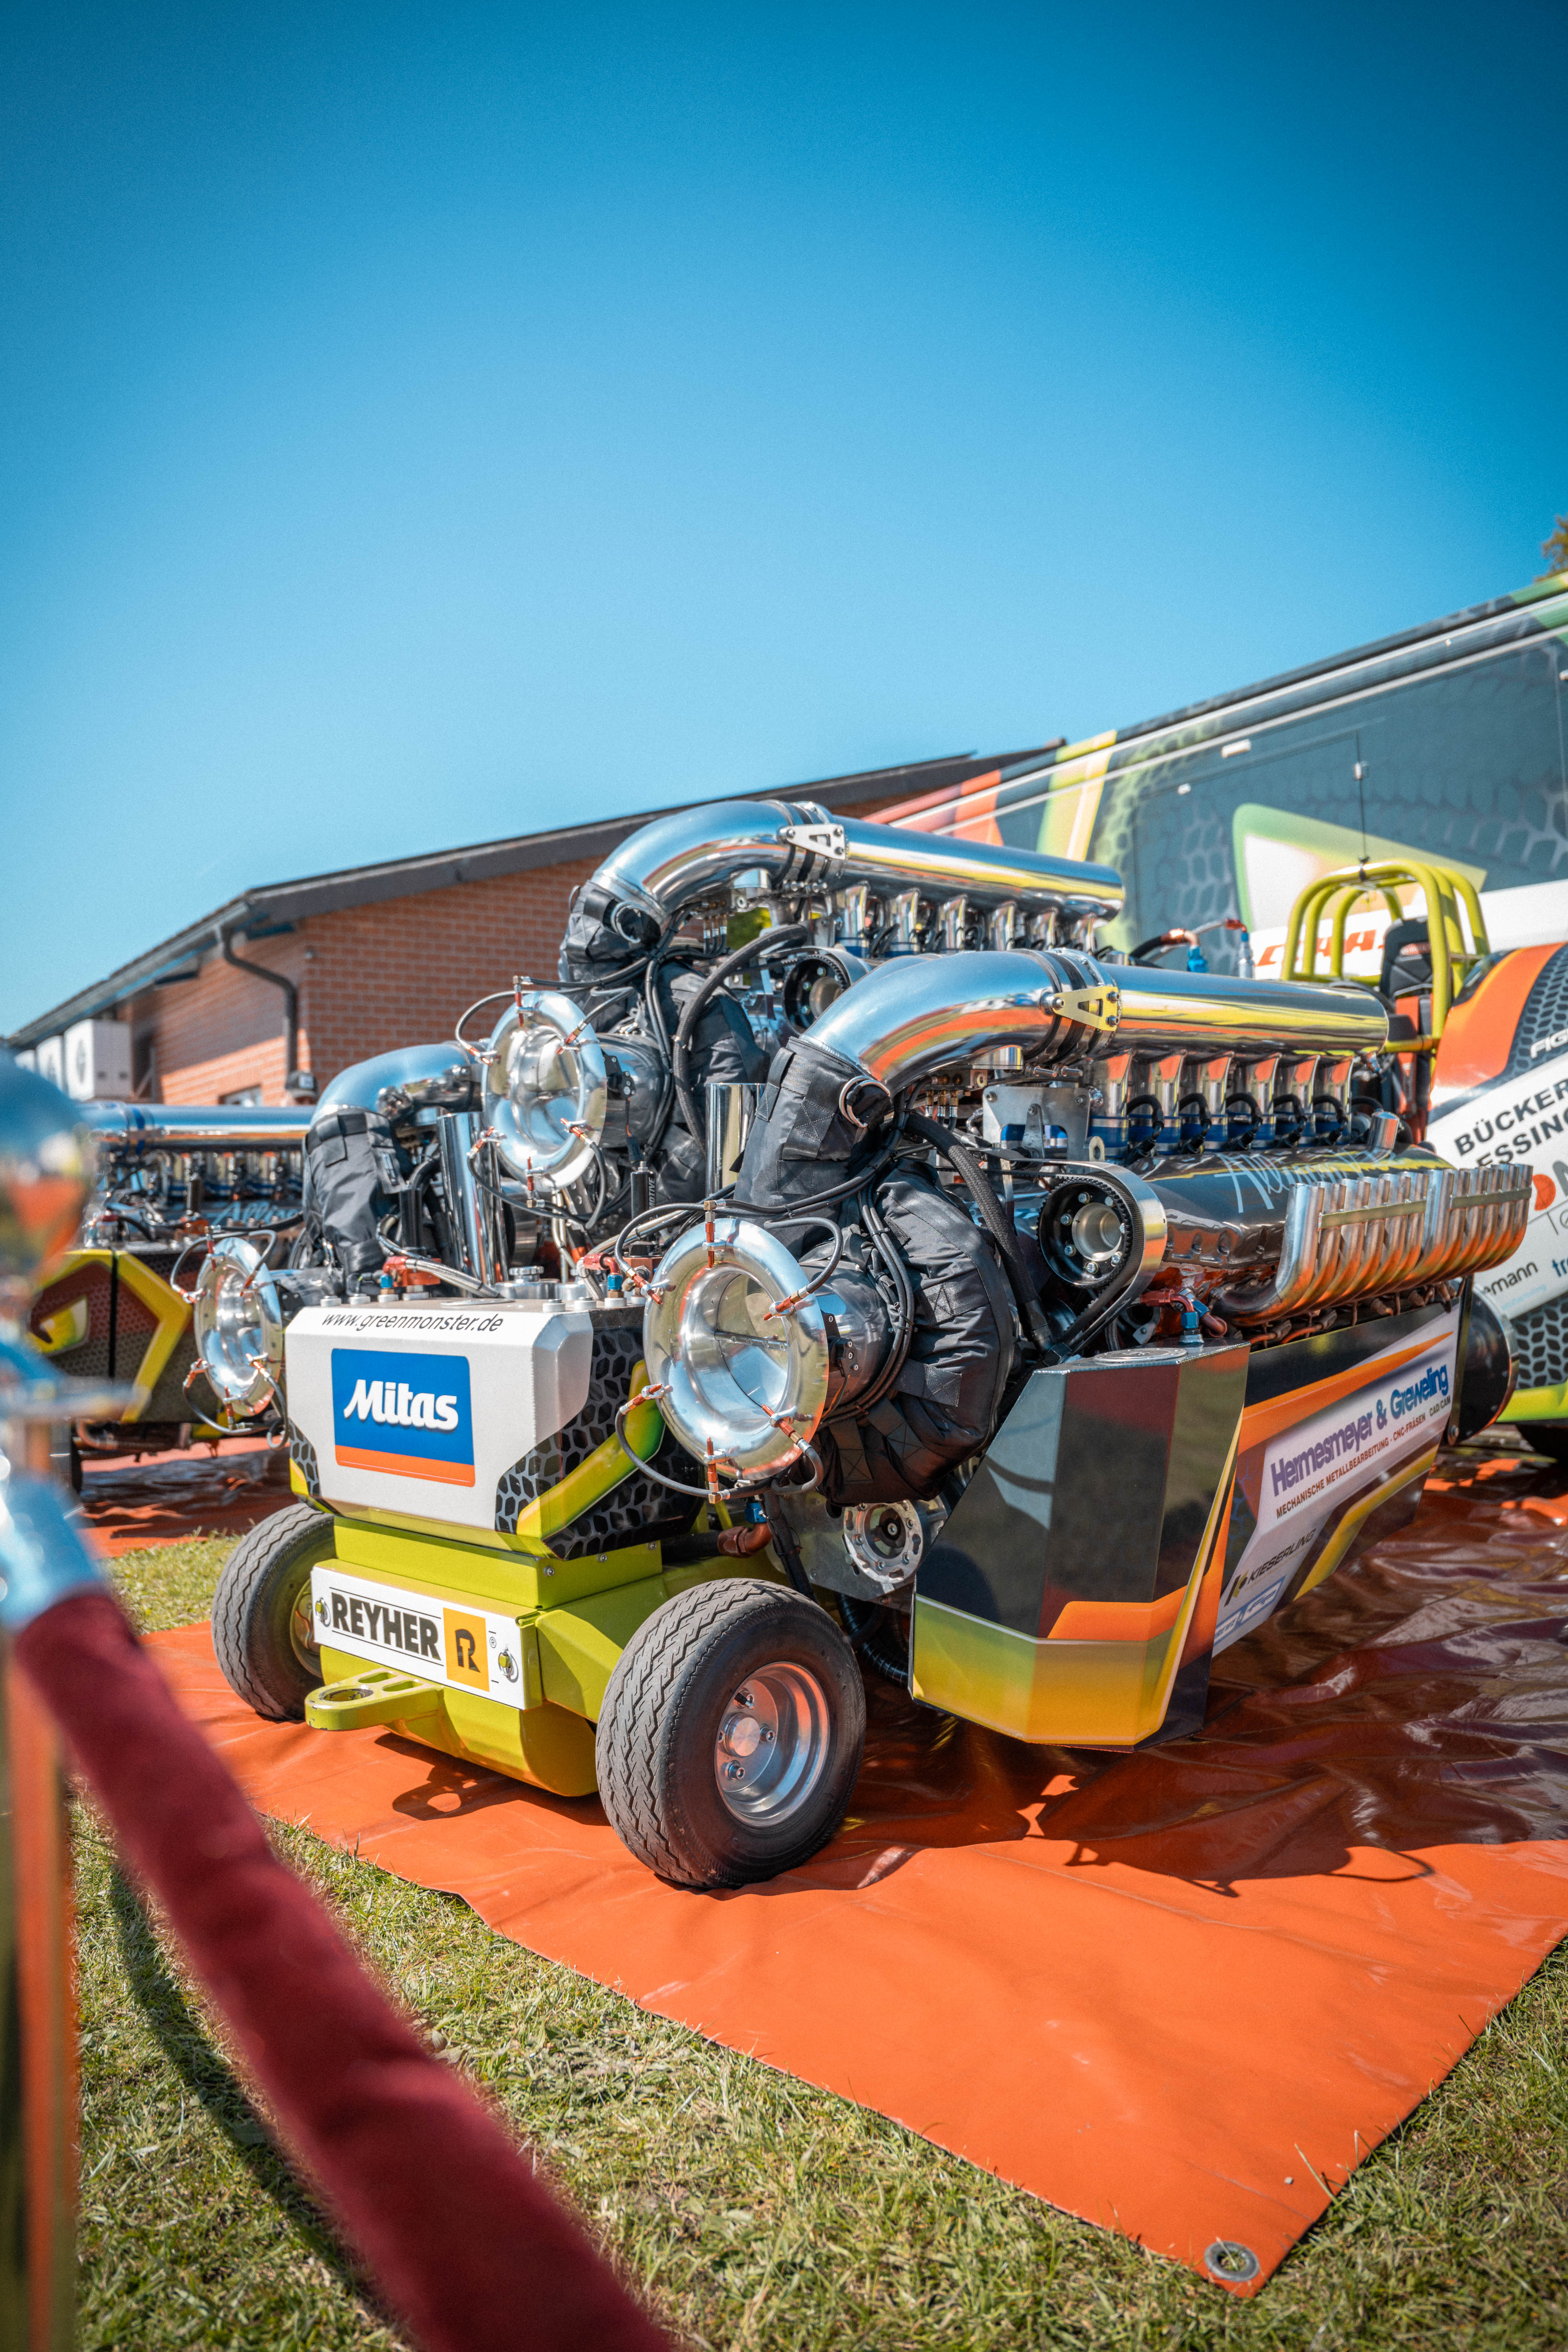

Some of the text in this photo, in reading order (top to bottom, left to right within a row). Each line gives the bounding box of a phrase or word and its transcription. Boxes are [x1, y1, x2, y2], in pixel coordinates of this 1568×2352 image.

[1455, 1079, 1568, 1156] BÜCKER
[1476, 1107, 1568, 1167] ESSIN
[322, 1313, 504, 1332] www.greenmonster.de
[343, 1379, 459, 1431] Mitas
[1270, 1364, 1449, 1497] Hermesmeyer & Greweling
[1276, 1479, 1325, 1519] MECHANISCHE
[1325, 1437, 1389, 1486] METALLBEARBEITUNG
[1429, 1395, 1451, 1417] CAD/CAM
[331, 1592, 441, 1661] REYHER
